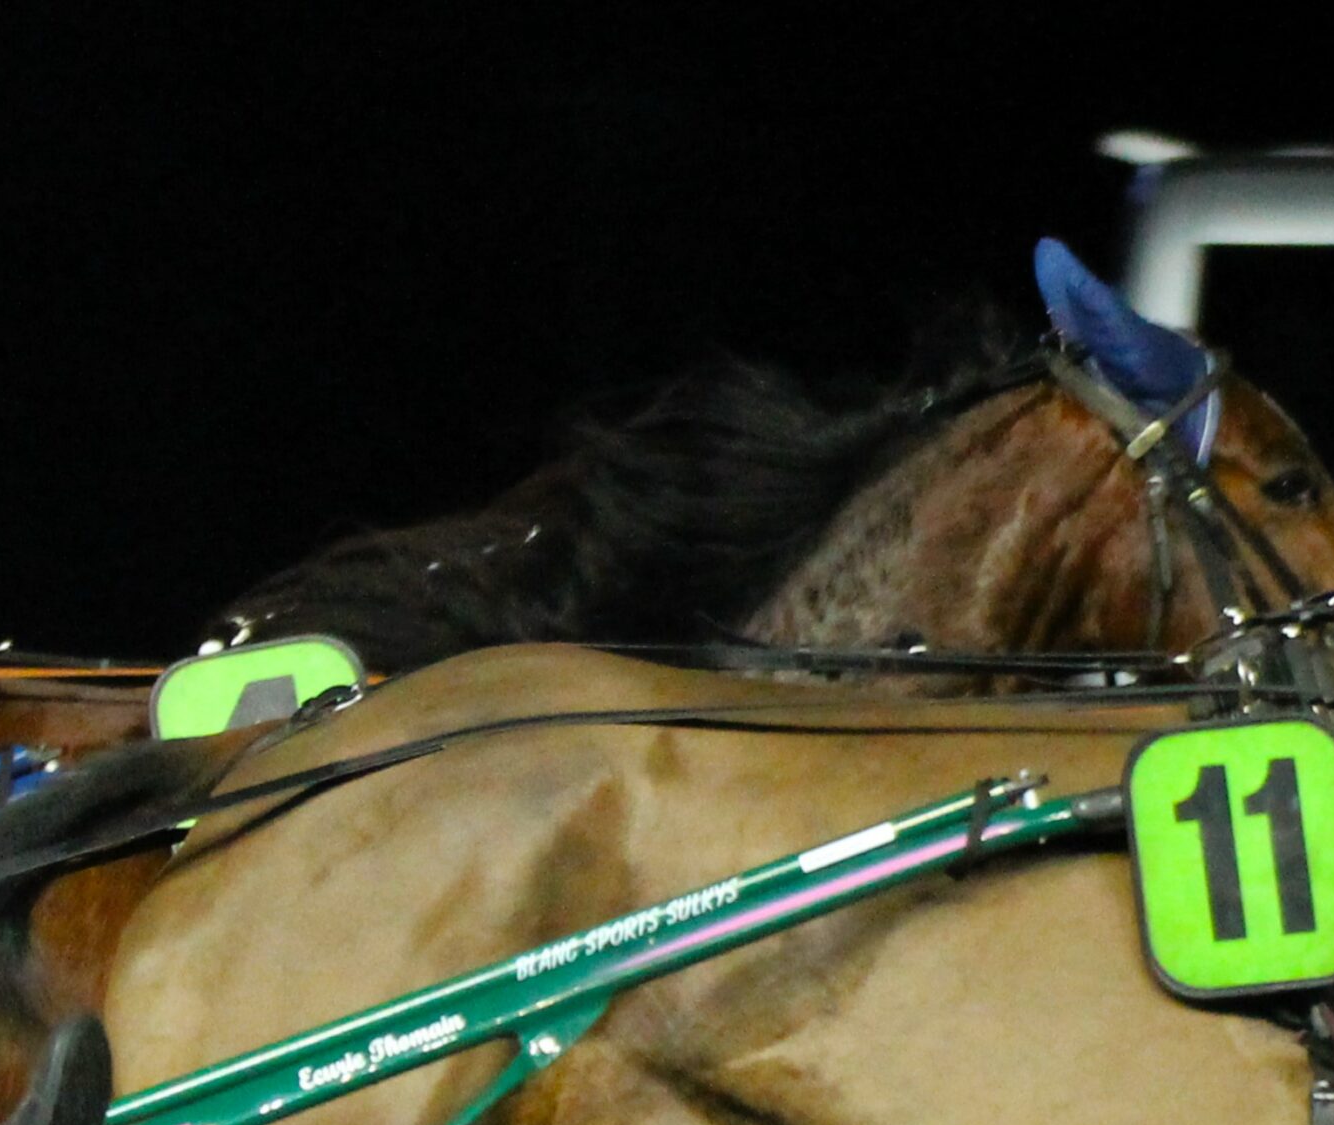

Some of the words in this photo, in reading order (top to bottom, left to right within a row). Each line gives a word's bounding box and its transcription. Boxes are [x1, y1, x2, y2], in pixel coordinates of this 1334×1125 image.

[1174, 758, 1317, 941] 11
[516, 937, 578, 981] BLANC
[585, 907, 659, 955] SPORTS
[666, 876, 740, 925] SULKYS
